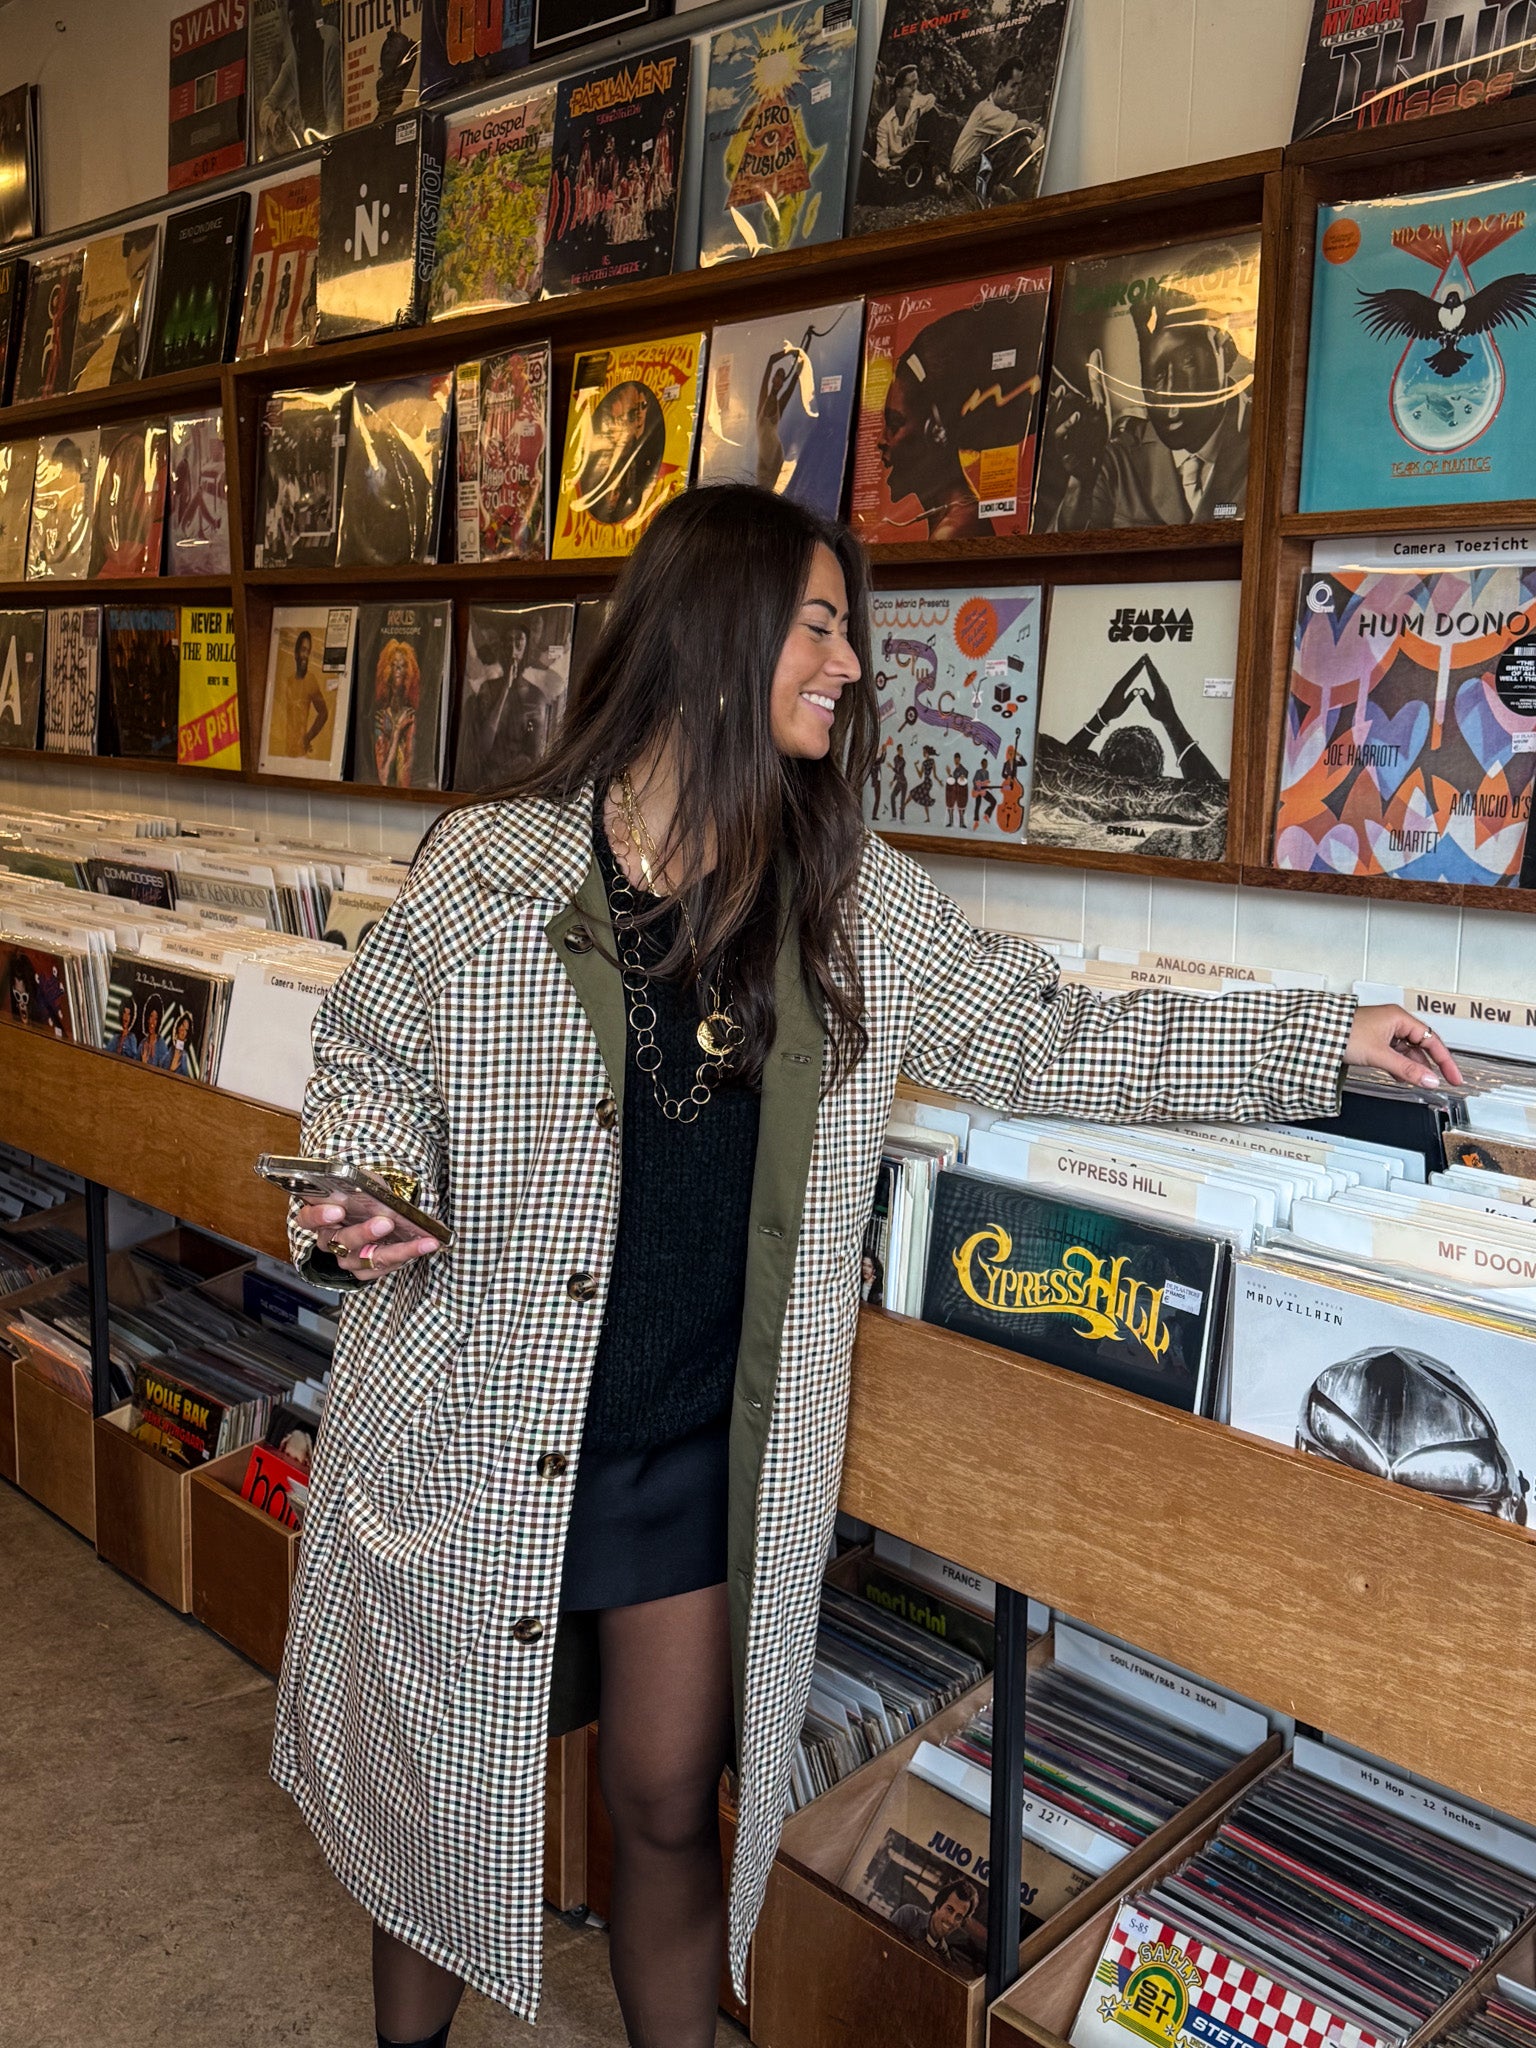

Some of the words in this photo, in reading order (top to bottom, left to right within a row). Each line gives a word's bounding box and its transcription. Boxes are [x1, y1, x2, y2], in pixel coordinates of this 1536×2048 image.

[172, 0, 246, 52] SWANS
[348, 0, 393, 42] LITTLE
[893, 22, 917, 39] LEE
[920, 8, 971, 31] KONITZ
[961, 24, 995, 39] WARNE
[996, 15, 1032, 30] MARSH
[1321, 9, 1351, 38] MY
[1351, 0, 1401, 31] BACK
[570, 57, 677, 118] PARLIAMENT
[755, 105, 790, 130] AFRO
[458, 128, 481, 162] The
[483, 105, 528, 140] Gospel
[480, 141, 493, 161] of
[739, 141, 798, 176] FUSION
[418, 153, 442, 282] STIKSTOF
[1451, 210, 1527, 236] MOCTAR
[1393, 542, 1446, 556] Camera
[1455, 537, 1529, 553] Toezicht
[873, 599, 893, 610] Coco
[895, 598, 917, 609] Maria
[919, 597, 950, 609] Presents
[191, 612, 222, 634] NEVER
[1108, 624, 1193, 643] GROOVE
[1358, 612, 1424, 638] HUM
[1435, 611, 1530, 637] DONO
[183, 642, 201, 660] THE
[1323, 744, 1344, 767] JOE
[1346, 745, 1400, 767] HARRIOTT
[1449, 793, 1507, 818] AMANCIO
[1389, 829, 1440, 854] QUARTET
[104, 866, 164, 888] COMMODORES
[207, 884, 265, 909] KENDRICKS
[200, 909, 218, 921] GLADYS
[219, 912, 238, 924] KNIGHT
[1156, 957, 1206, 975] ANALOG
[1209, 966, 1256, 981] AFRICA
[271, 976, 294, 991] Camera
[298, 981, 328, 996] Toezicht
[1417, 994, 1456, 1015] New
[1470, 1001, 1511, 1023] New
[1058, 1156, 1128, 1188] CYPRESS
[1133, 1175, 1167, 1198] HILL
[1438, 1240, 1467, 1262] MF
[1474, 1249, 1536, 1279] DOOM
[952, 1223, 1105, 1325] CYPRESS
[1063, 1246, 1170, 1364] HILL
[1246, 1289, 1343, 1326] MADVILLAIN
[146, 1379, 182, 1416] VOLLE
[182, 1399, 209, 1431] BAK
[942, 1565, 982, 1591] FRANCE
[909, 1602, 946, 1637] trini
[1110, 1654, 1175, 1690] SOUL/FUNK/R&B
[1180, 1686, 1191, 1698] 12
[1195, 1694, 1217, 1709] INCH
[1361, 1770, 1380, 1785] Hip
[1385, 1781, 1404, 1796] Hop
[1423, 1799, 1436, 1810] 12
[1442, 1806, 1482, 1831] inches
[928, 1831, 973, 1867] JULIO
[1128, 1918, 1149, 1934] S-85
[1139, 1942, 1203, 1987] SALLY
[1139, 1979, 1176, 2007] ST
[1133, 1995, 1170, 2024] ET
